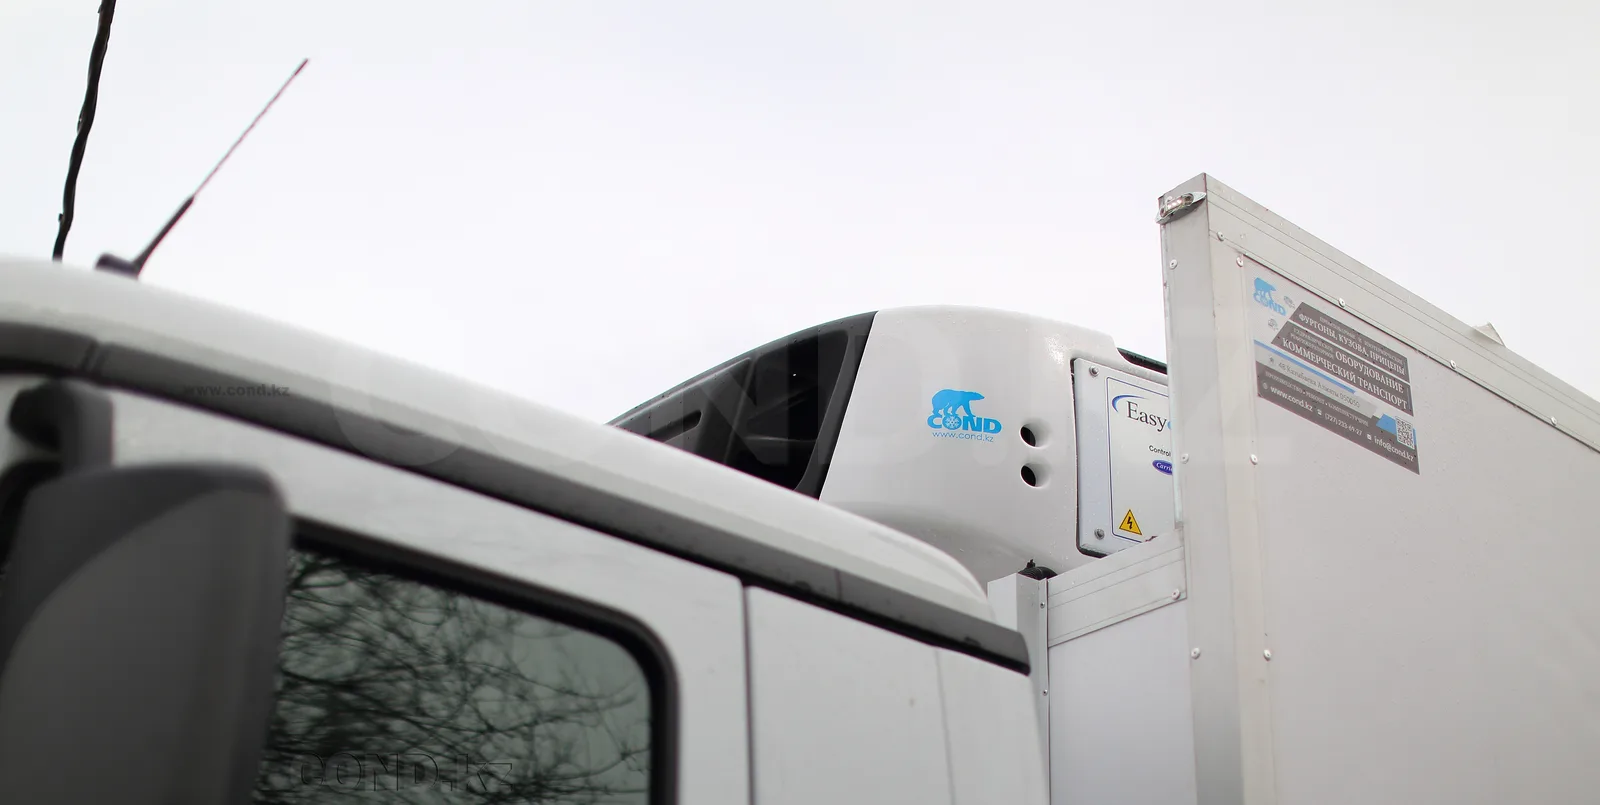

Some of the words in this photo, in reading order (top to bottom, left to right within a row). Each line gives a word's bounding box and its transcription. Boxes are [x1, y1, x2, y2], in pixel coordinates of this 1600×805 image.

[1253, 290, 1286, 316] COND
[1298, 313, 1338, 341] ФУРГОНЫ,
[1338, 333, 1369, 357] КУЗОВА,
[1369, 350, 1405, 375] ПРИЦЕПЫ
[1282, 337, 1356, 384] КОММЕРЧЕСКИЙ
[1357, 376, 1408, 410] ТРАНСПОРТ
[1335, 350, 1404, 394] ОБОРУДОВАНИЕ
[927, 413, 1002, 434] COND
[932, 430, 994, 443] www.cond.kz
[1270, 386, 1313, 412] www.cond.kz
[1374, 436, 1414, 462] info@cond.kz
